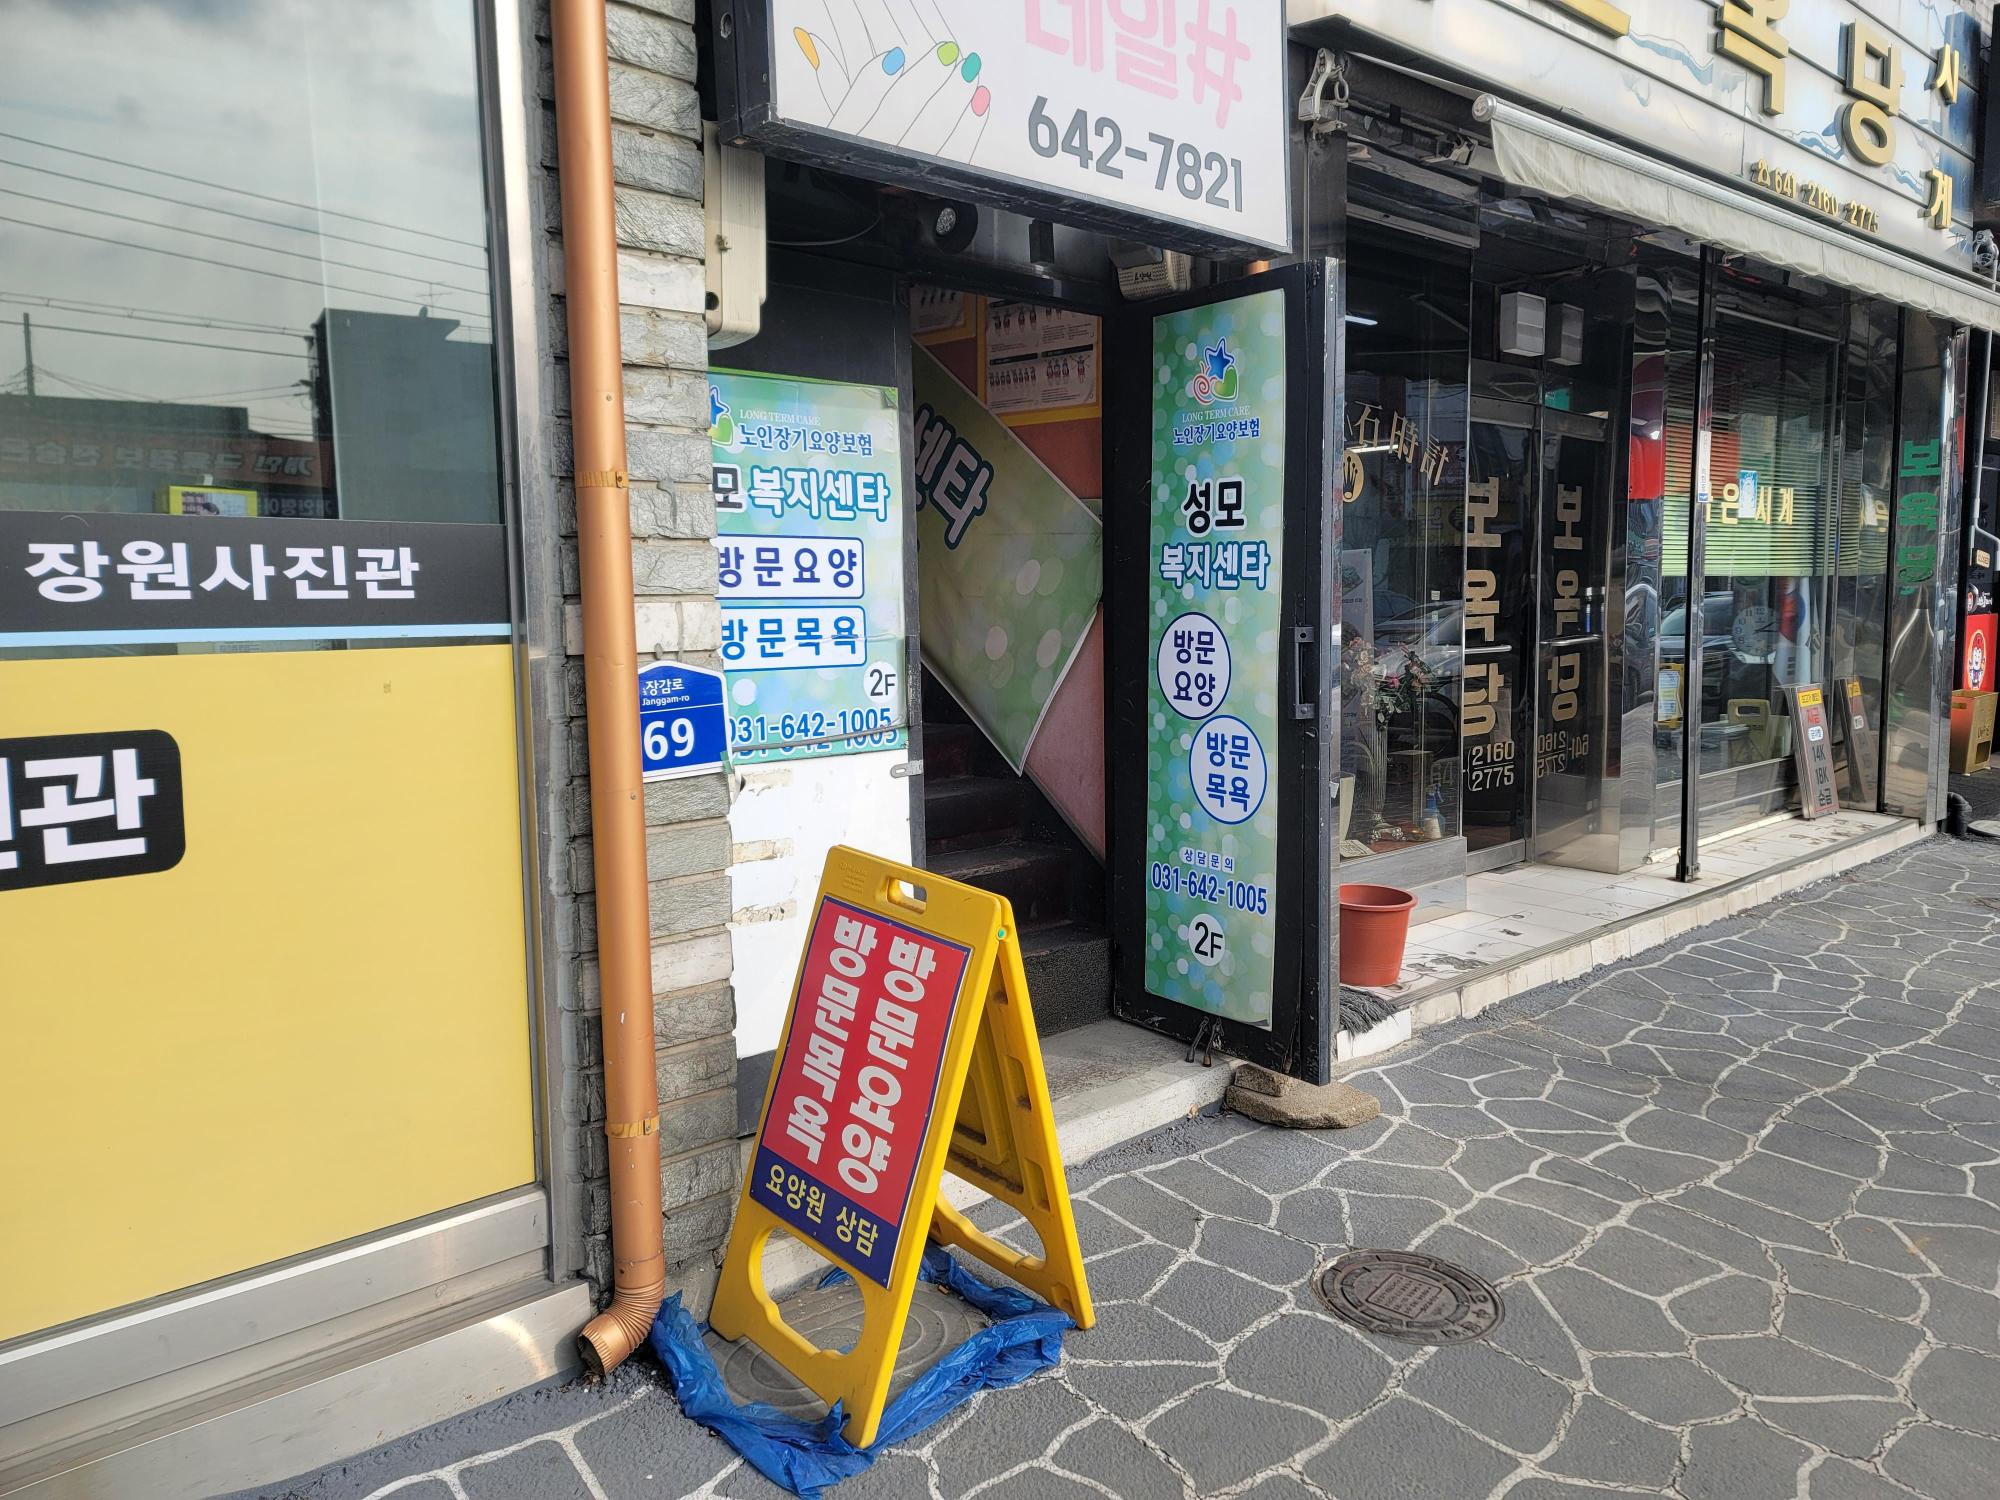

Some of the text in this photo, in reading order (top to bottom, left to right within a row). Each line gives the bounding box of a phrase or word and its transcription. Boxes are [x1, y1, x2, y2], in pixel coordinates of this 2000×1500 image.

[1028, 95, 1243, 213] 642-7821
[1775, 168, 1880, 234] 641 2160 2775
[739, 408, 822, 427] LONG TERM CARE
[1173, 418, 1260, 446] 노인장기요양보험
[1182, 405, 1251, 424] LONG TERM CARE
[739, 424, 873, 457] 노인장기요양보험
[750, 466, 890, 521] 복지센타
[1183, 477, 1246, 535] 성모
[25, 540, 421, 603] 장원사진관
[718, 546, 857, 588] 방문요양
[1160, 540, 1270, 590] 복지센타
[721, 616, 859, 660] 방문목욕
[1174, 630, 1215, 665] 방문
[642, 695, 690, 706] Janggam-ro
[645, 678, 685, 696] 장감로
[869, 668, 896, 697] 2F
[1173, 671, 1216, 707] 요양
[643, 718, 695, 761] 69
[1207, 732, 1251, 770] 방문
[1471, 740, 1515, 765] 2160
[1206, 773, 1251, 813] 목욕
[1471, 765, 1515, 792] 2775
[1184, 848, 1234, 872] 상담문의
[1152, 862, 1268, 916] 031-642-1005
[1194, 921, 1224, 958] 2F
[786, 914, 879, 1165] 방문목욕
[837, 936, 937, 1194] 방문요양
[765, 1164, 879, 1258] 요양원 상담
